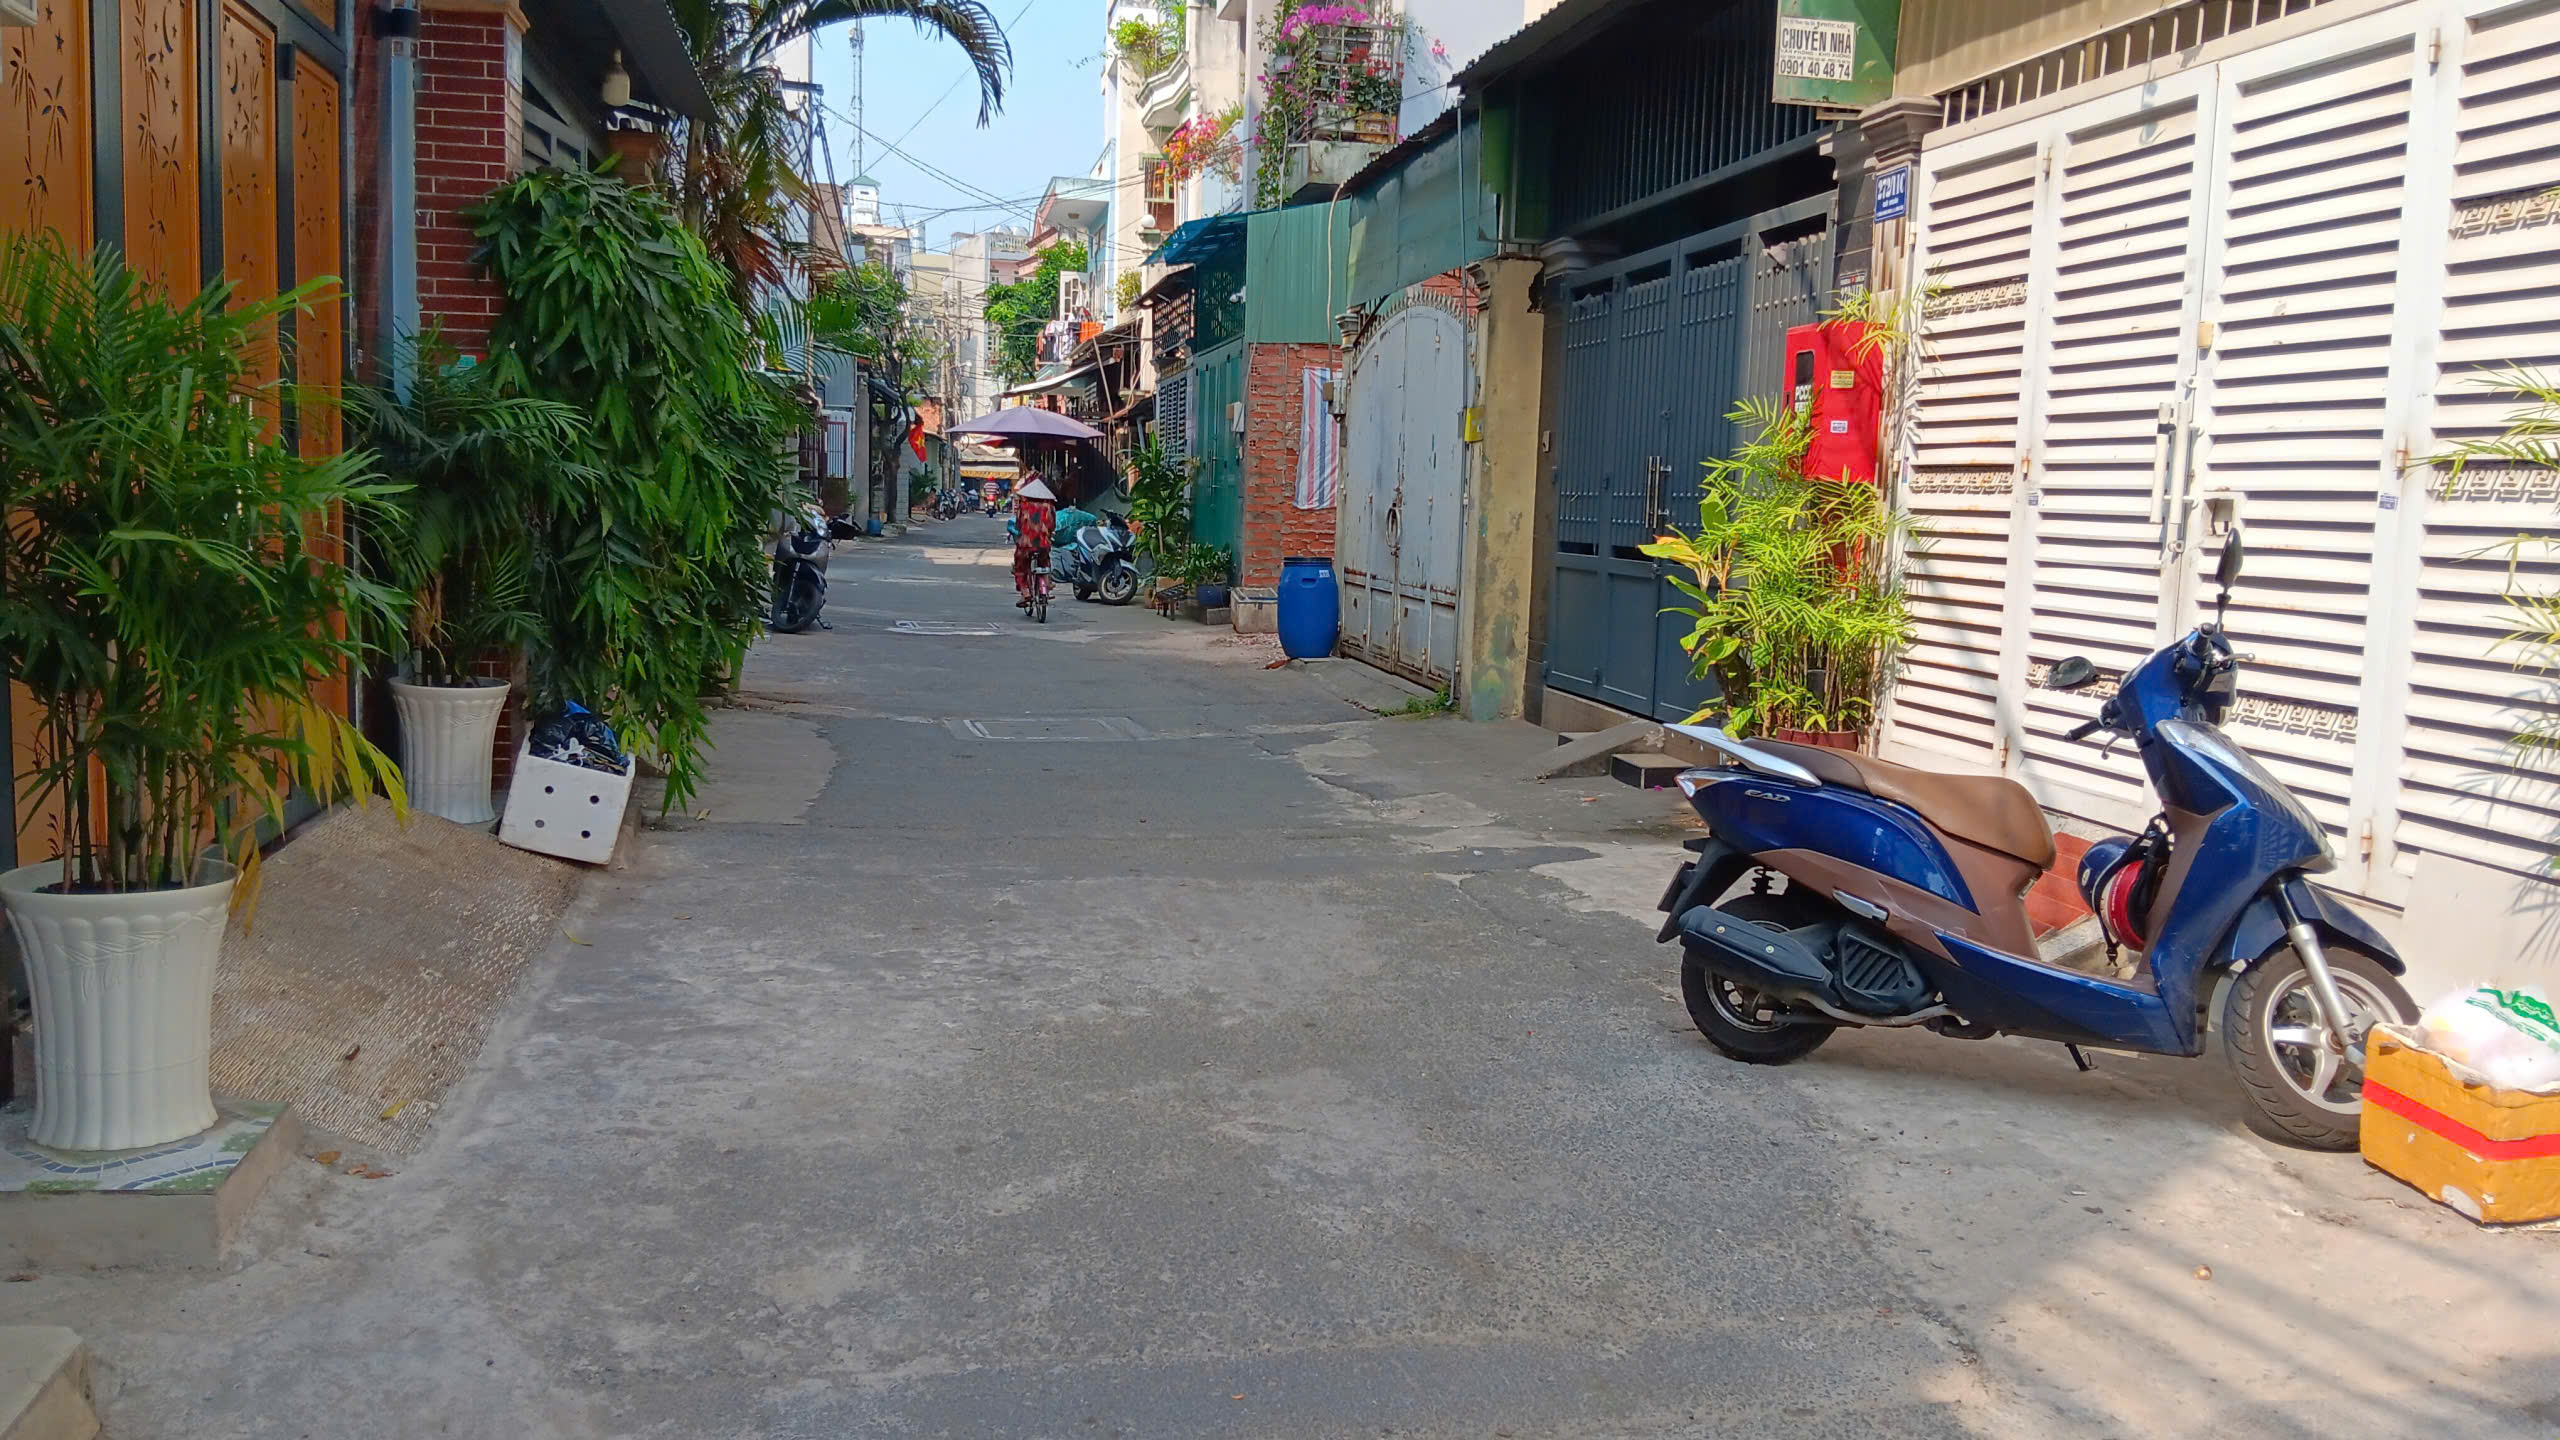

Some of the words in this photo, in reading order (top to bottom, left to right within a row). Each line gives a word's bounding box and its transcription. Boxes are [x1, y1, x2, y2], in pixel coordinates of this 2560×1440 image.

[1830, 28, 1851, 54] NHÀ
[1780, 59, 1803, 75] 0901
[1807, 61, 1820, 77] 40
[1822, 62, 1836, 78] 48
[1838, 63, 1850, 79] 74
